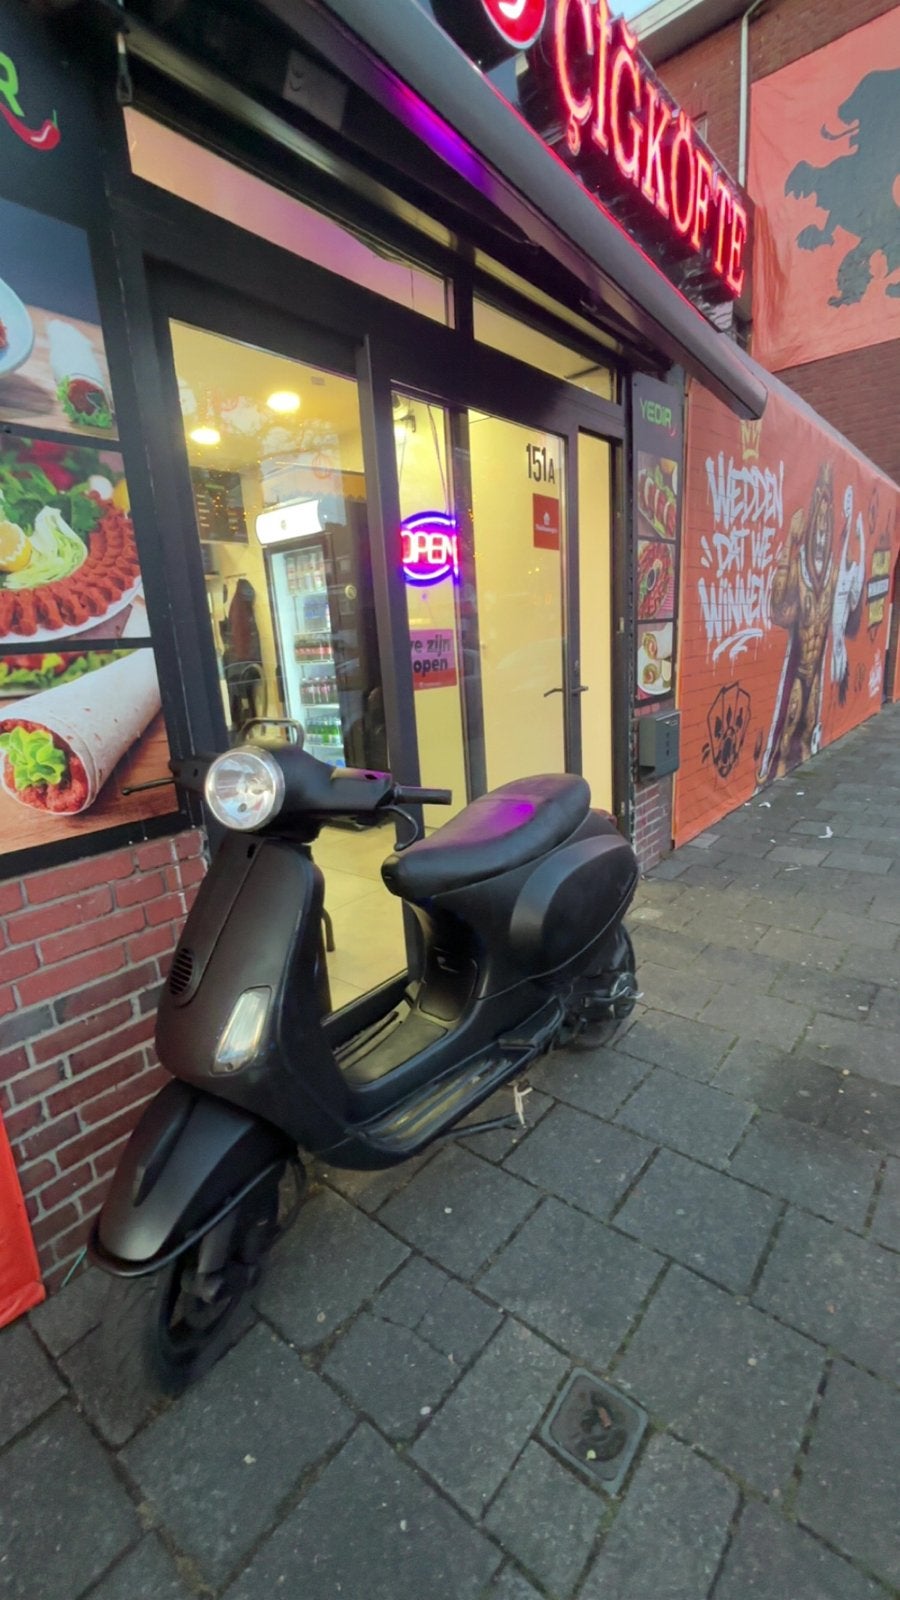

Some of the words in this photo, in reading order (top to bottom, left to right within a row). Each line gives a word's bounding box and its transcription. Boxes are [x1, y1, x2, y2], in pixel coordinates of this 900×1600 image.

[526, 443, 556, 484] 151A
[706, 451, 784, 530] WEDDEN
[401, 531, 459, 576] OPEN
[752, 527, 776, 570] WE
[413, 658, 449, 677] open
